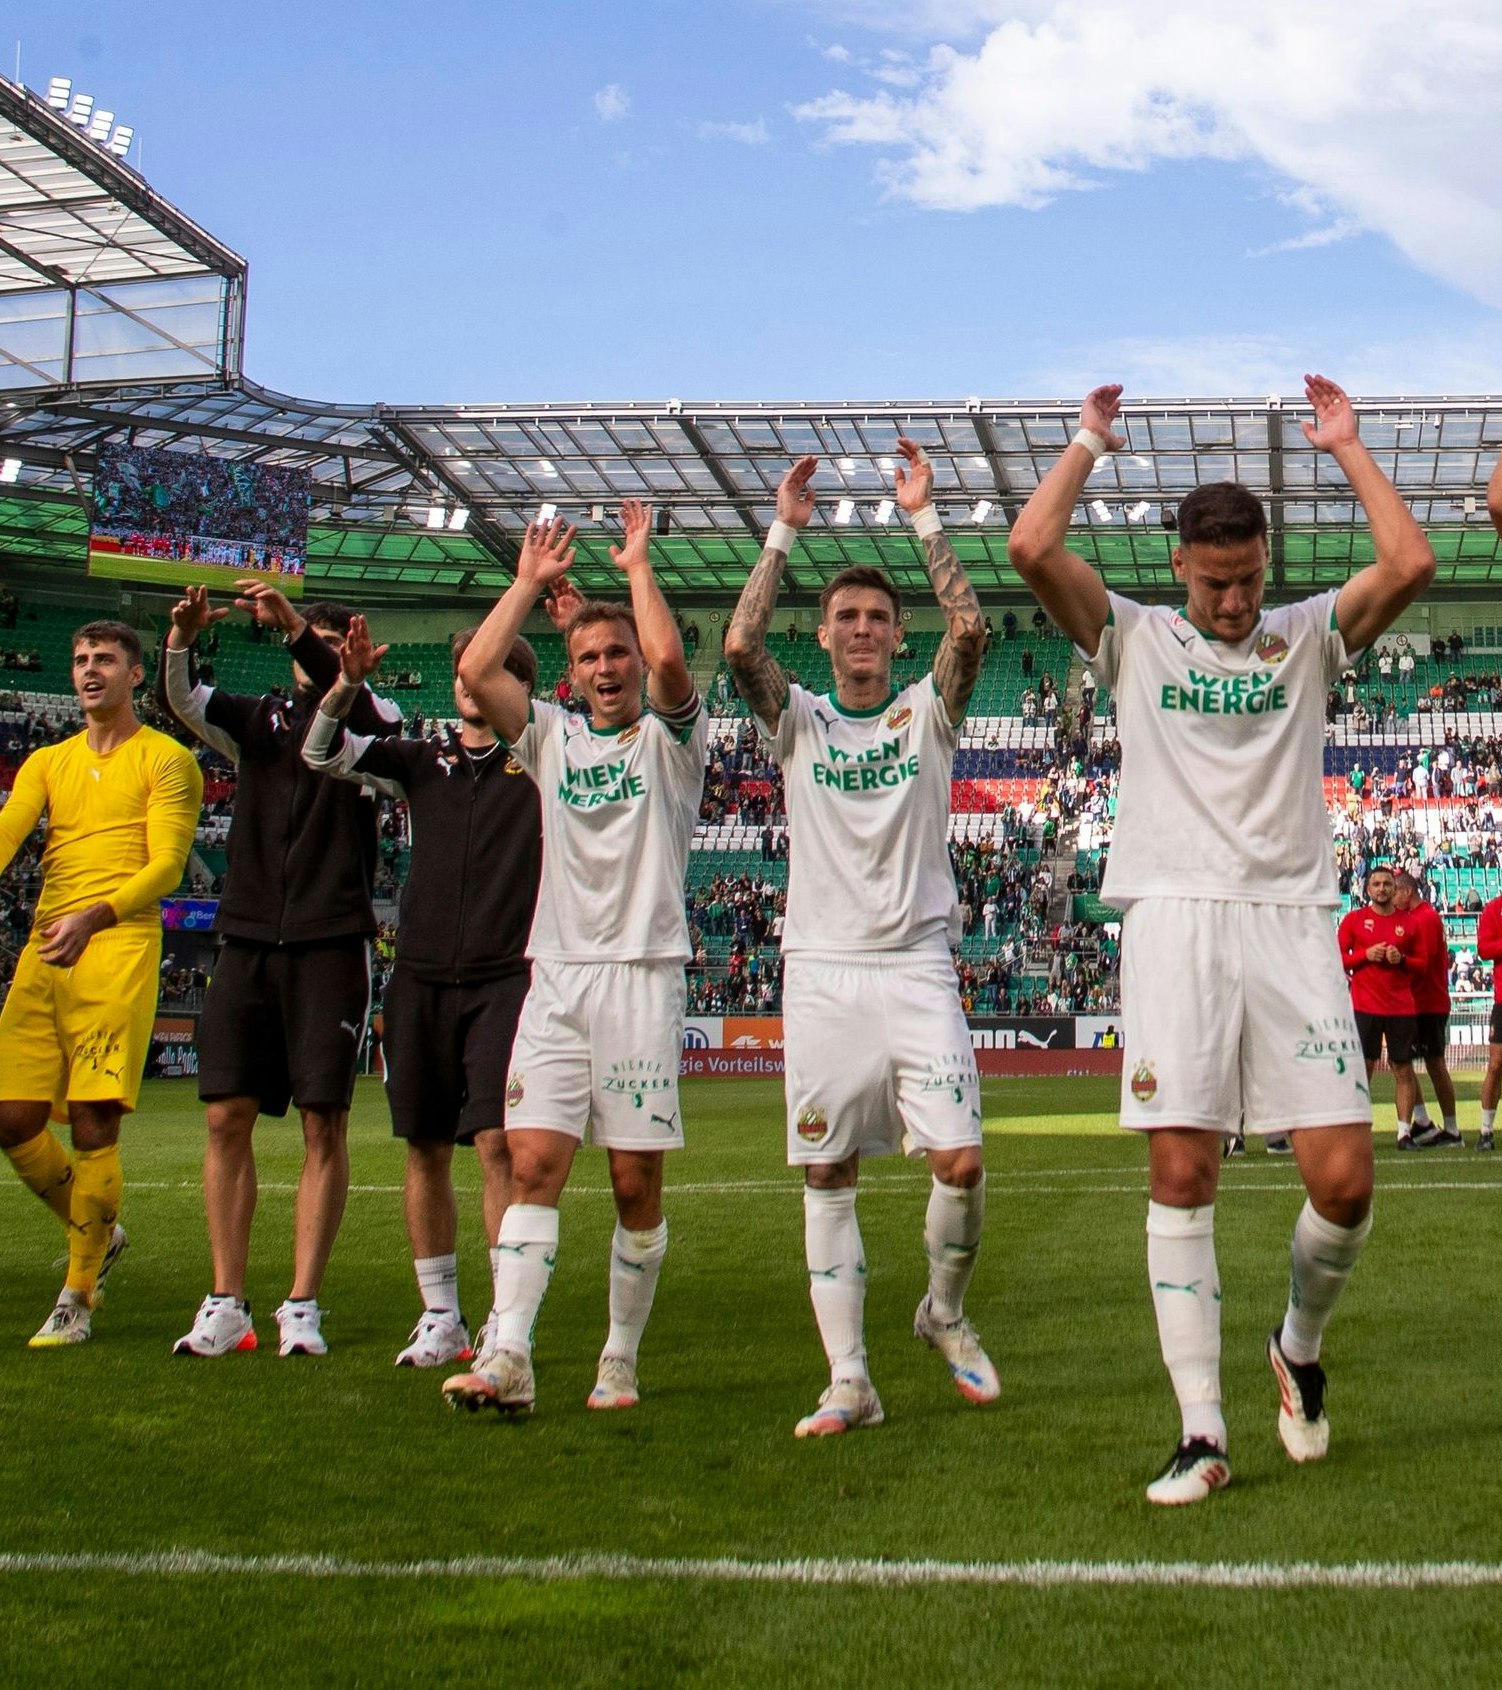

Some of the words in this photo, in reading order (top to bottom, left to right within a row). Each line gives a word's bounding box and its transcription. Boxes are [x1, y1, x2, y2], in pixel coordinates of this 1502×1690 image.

[1161, 685, 1289, 714] ENERGIE
[813, 755, 919, 791] ENERGIE
[559, 775, 646, 807] NERGIE
[1295, 1040, 1360, 1057] ZUCKE
[679, 1057, 704, 1075] gie
[708, 1056, 785, 1073] Vorteilsw
[602, 1077, 671, 1091] ZUCKER
